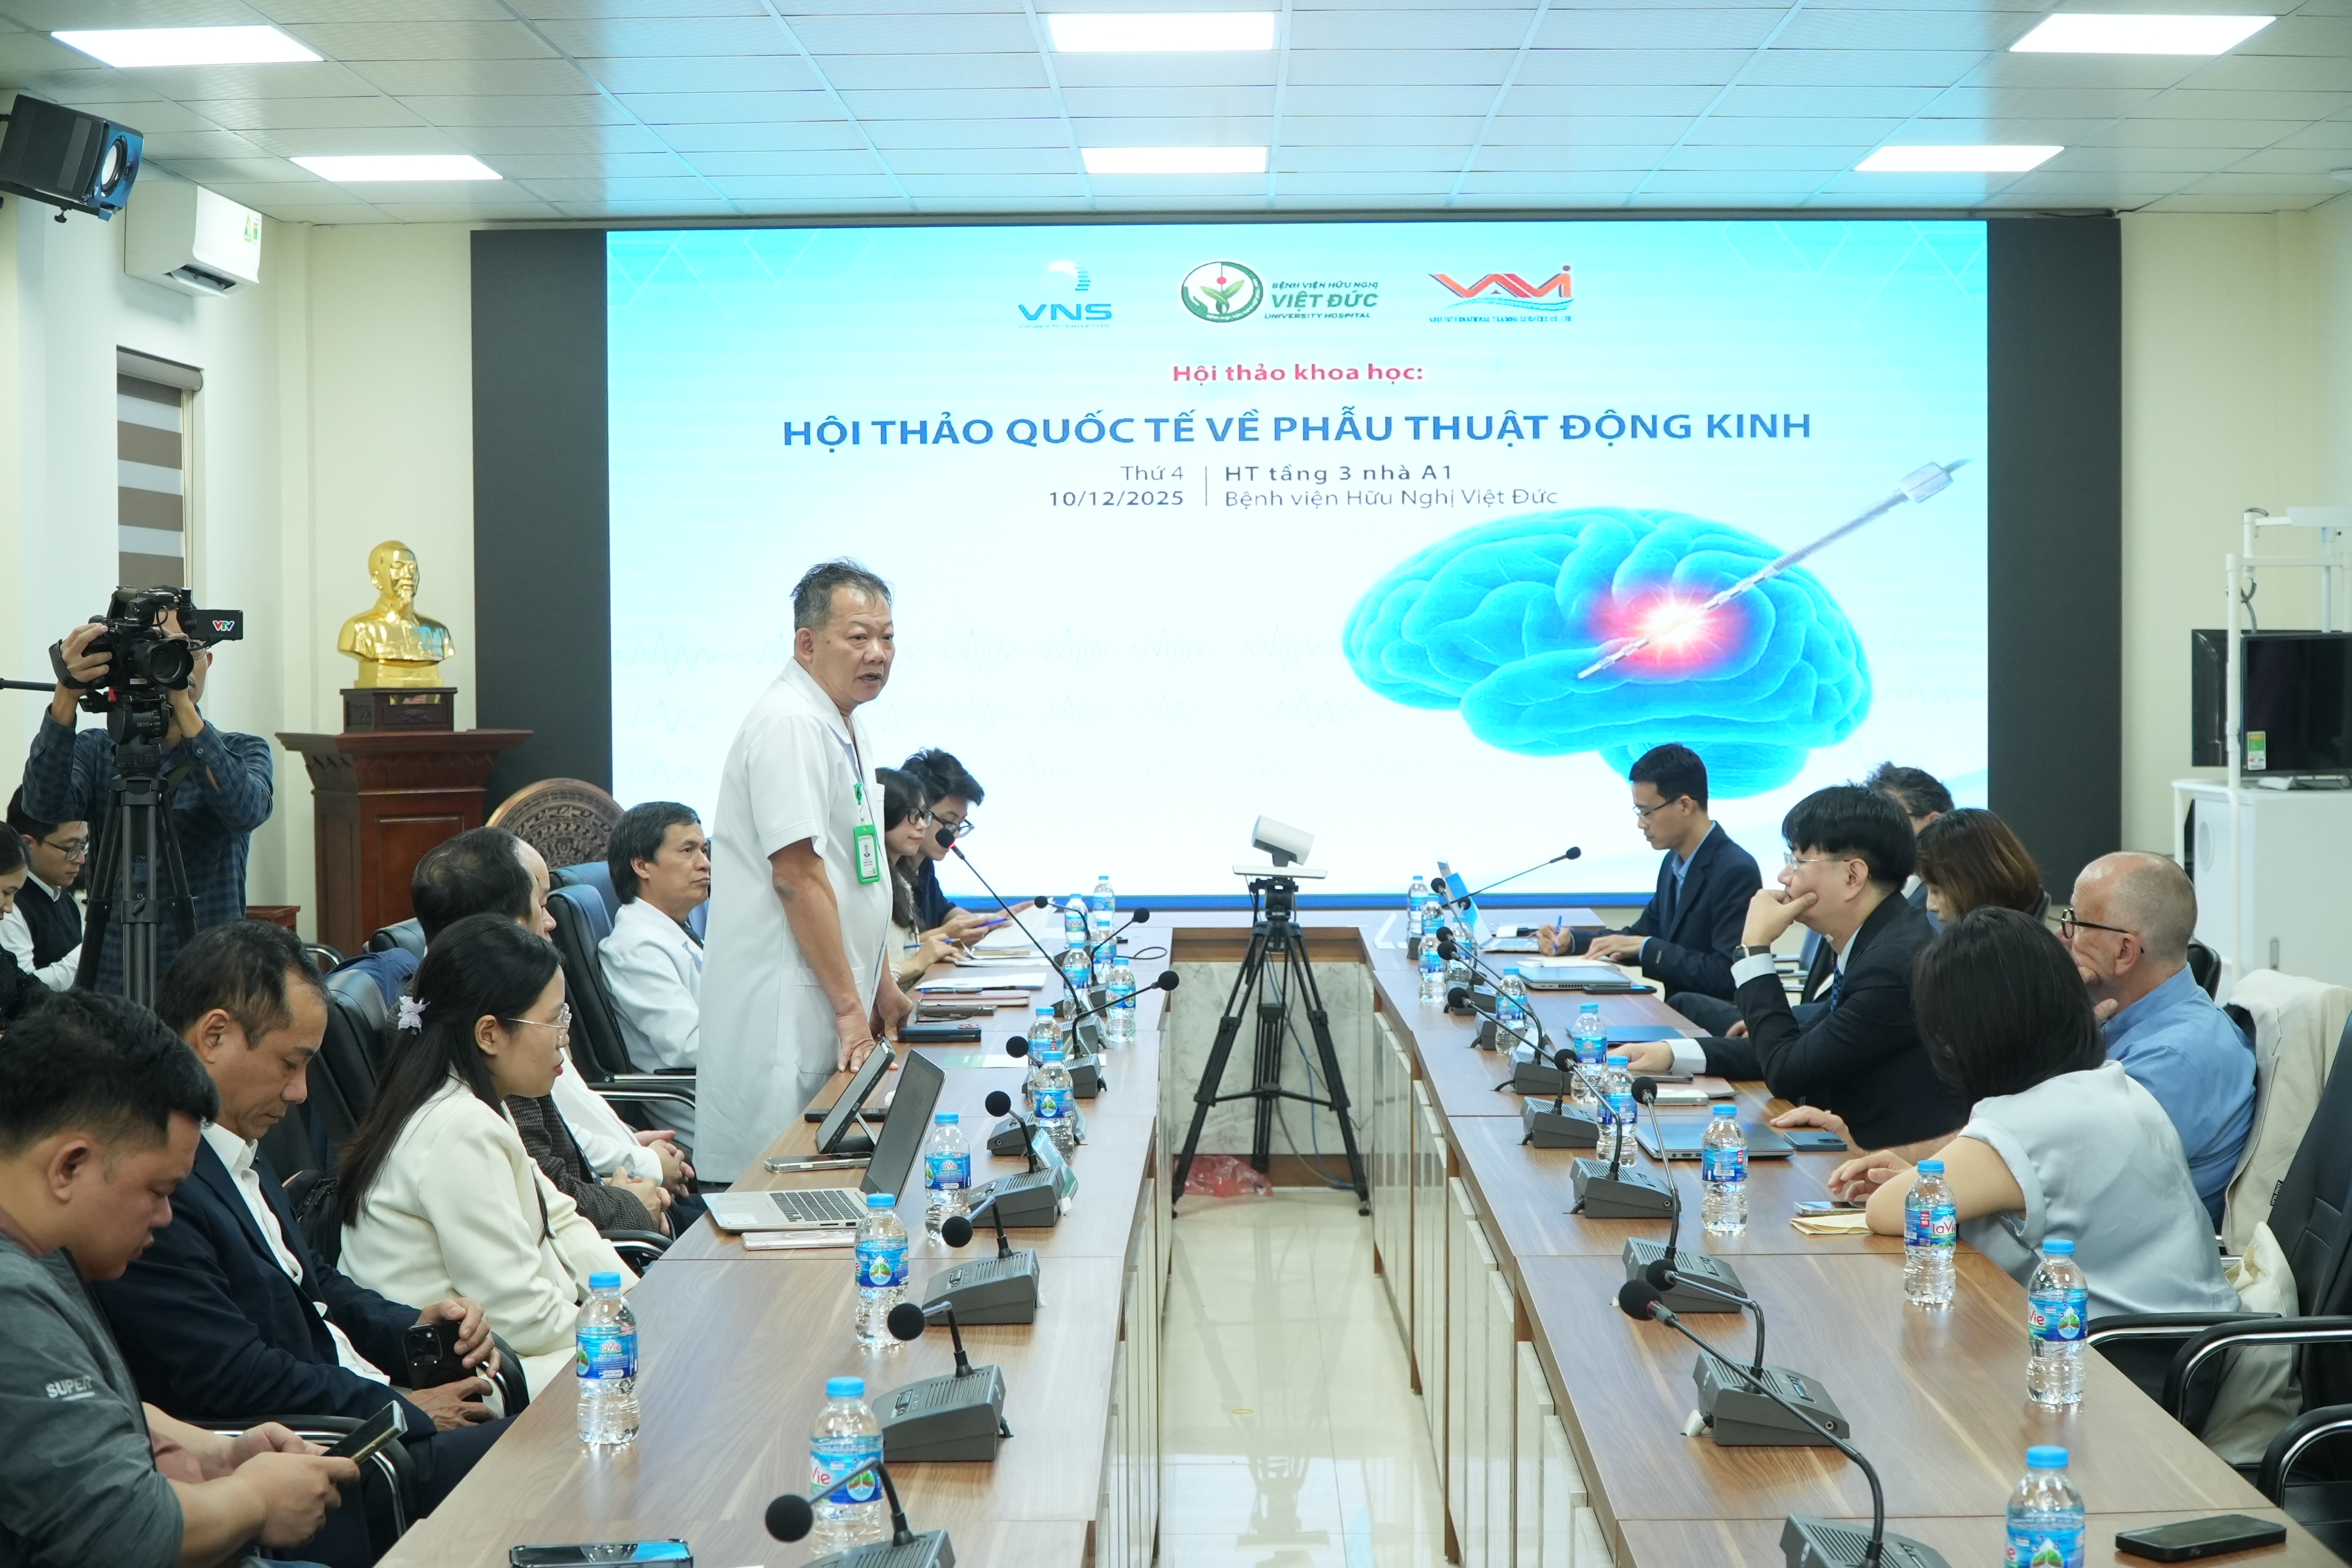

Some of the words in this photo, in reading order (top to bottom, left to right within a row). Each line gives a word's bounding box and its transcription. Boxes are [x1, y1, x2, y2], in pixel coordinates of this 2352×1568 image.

[1272, 281, 1300, 290] BỆNH
[1303, 281, 1326, 289] VIỆN
[1328, 281, 1352, 289] HỮU
[1353, 281, 1378, 289] NGHỊ
[1271, 290, 1324, 312] VIỆT
[1327, 290, 1378, 307] ĐỨC
[1018, 304, 1112, 321] VNS
[1173, 365, 1217, 386] Hội
[1225, 363, 1286, 381] thảo
[1294, 363, 1359, 381] khoa
[1368, 363, 1423, 385] học:
[784, 415, 860, 453] HỘI
[871, 411, 993, 445] THẢO
[1006, 409, 1135, 448] QUỐC
[1144, 409, 1196, 443] TẾ
[1205, 408, 1260, 442] VỀ
[1274, 406, 1392, 442] PHẪU
[1404, 409, 1549, 448] THUẬT
[1559, 409, 1691, 447] ĐỘNG
[1707, 413, 1810, 438] KINH
[1120, 465, 1165, 481] Thứ
[1171, 466, 1184, 480] 4
[1226, 466, 1259, 481] HT
[1269, 463, 1327, 485] tầng
[1339, 465, 1351, 480] 3
[1363, 464, 1410, 480] nhà
[1421, 464, 1450, 480] A1
[1049, 491, 1183, 507] 10/12/2025
[1226, 491, 1283, 509] Bệnh
[1290, 490, 1338, 509] viện
[1347, 489, 1392, 505] Hữu
[1402, 488, 1454, 509] Nghị
[1461, 488, 1504, 508] Việt
[1511, 488, 1557, 505] Đức
[213, 620, 235, 631] VTV
